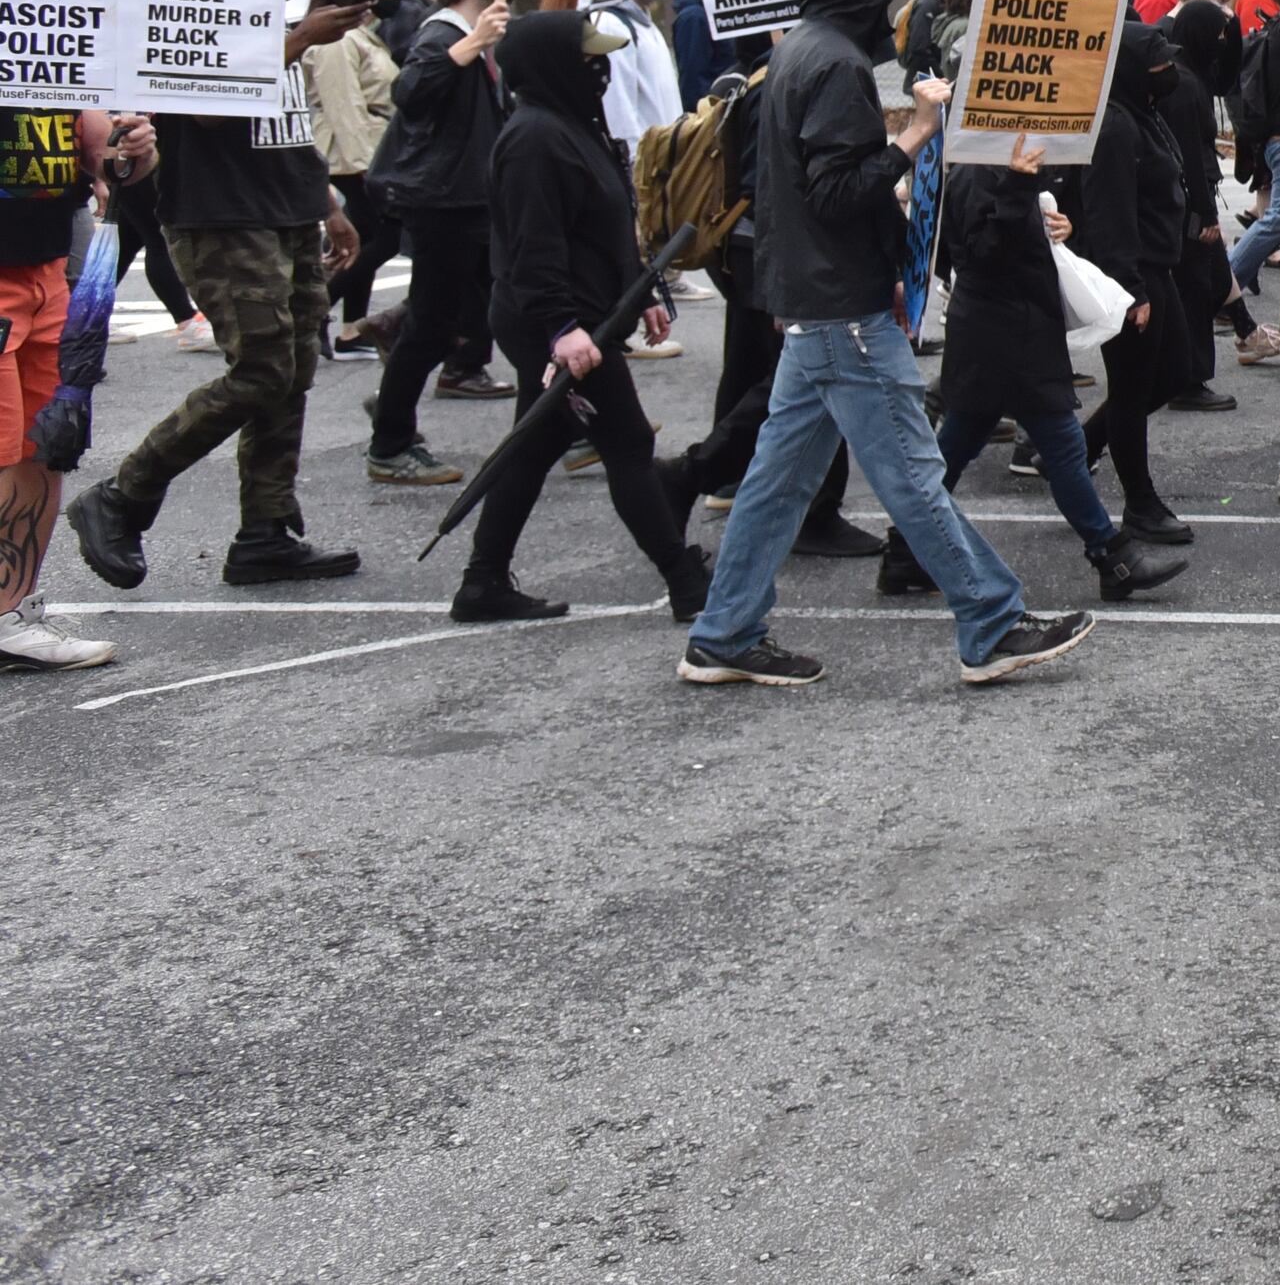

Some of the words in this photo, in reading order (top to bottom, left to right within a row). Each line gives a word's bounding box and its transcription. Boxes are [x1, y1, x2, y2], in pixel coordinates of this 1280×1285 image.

[148, 4, 241, 26] MURDER
[250, 11, 271, 27] of
[716, 17, 735, 28] Party
[789, 5, 801, 16] Lib
[148, 26, 218, 46] BLACK
[986, 24, 1079, 50] MURDER
[1085, 31, 1106, 52] of
[146, 48, 228, 68] PEOPLE
[982, 51, 1055, 76] BLACK
[0, 59, 86, 85] STATE
[149, 79, 262, 97] RefuseFascism.org
[975, 78, 1060, 103] PEOPLE
[0, 113, 82, 151] IVE
[965, 112, 1091, 133] RefuseFascism.org
